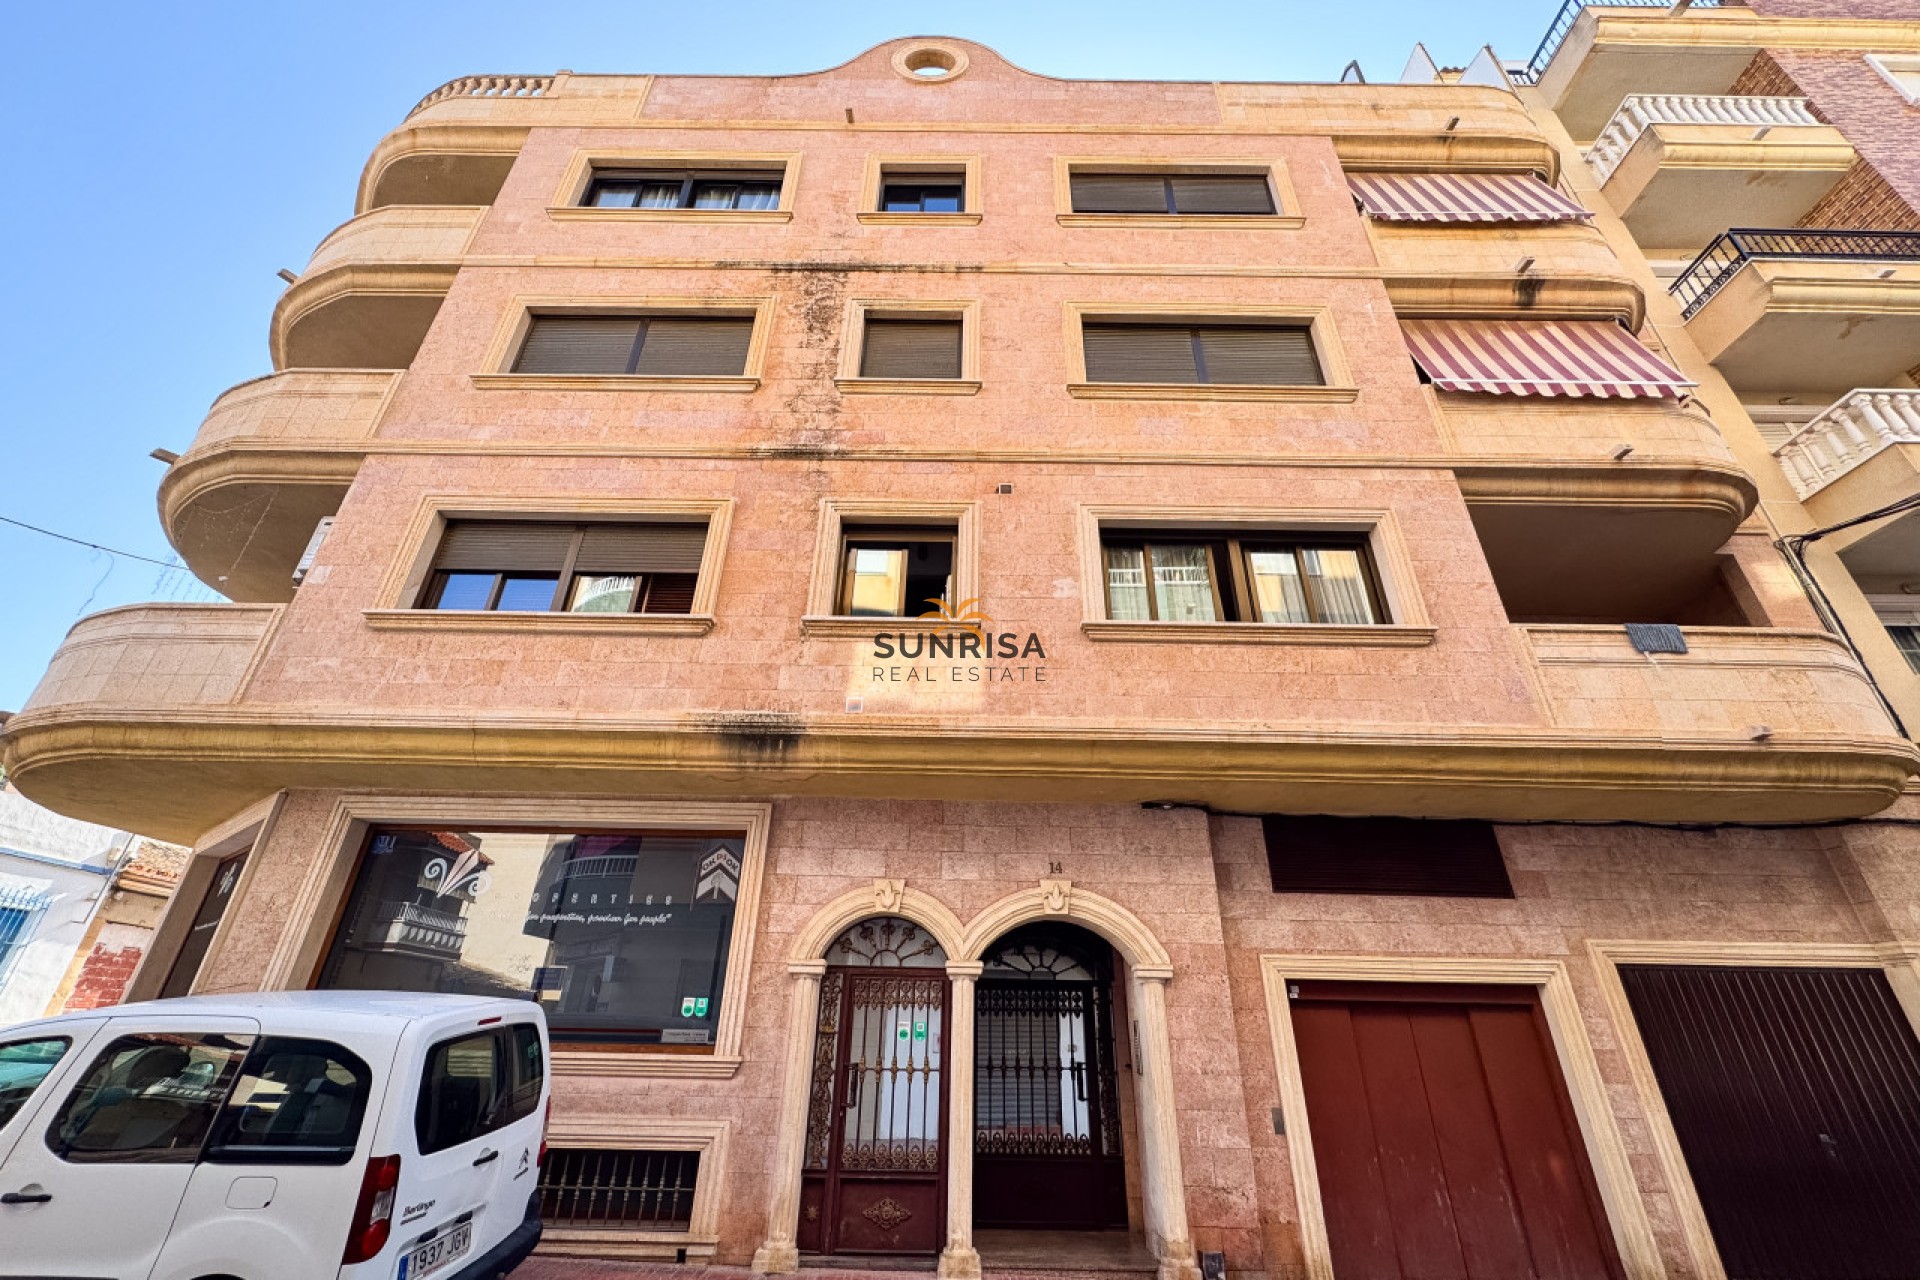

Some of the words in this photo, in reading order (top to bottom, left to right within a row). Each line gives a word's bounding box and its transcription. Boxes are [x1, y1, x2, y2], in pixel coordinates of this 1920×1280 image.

[1049, 861, 1062, 874] 14
[402, 1199, 436, 1218] Berlingo
[412, 1240, 445, 1274] 1937
